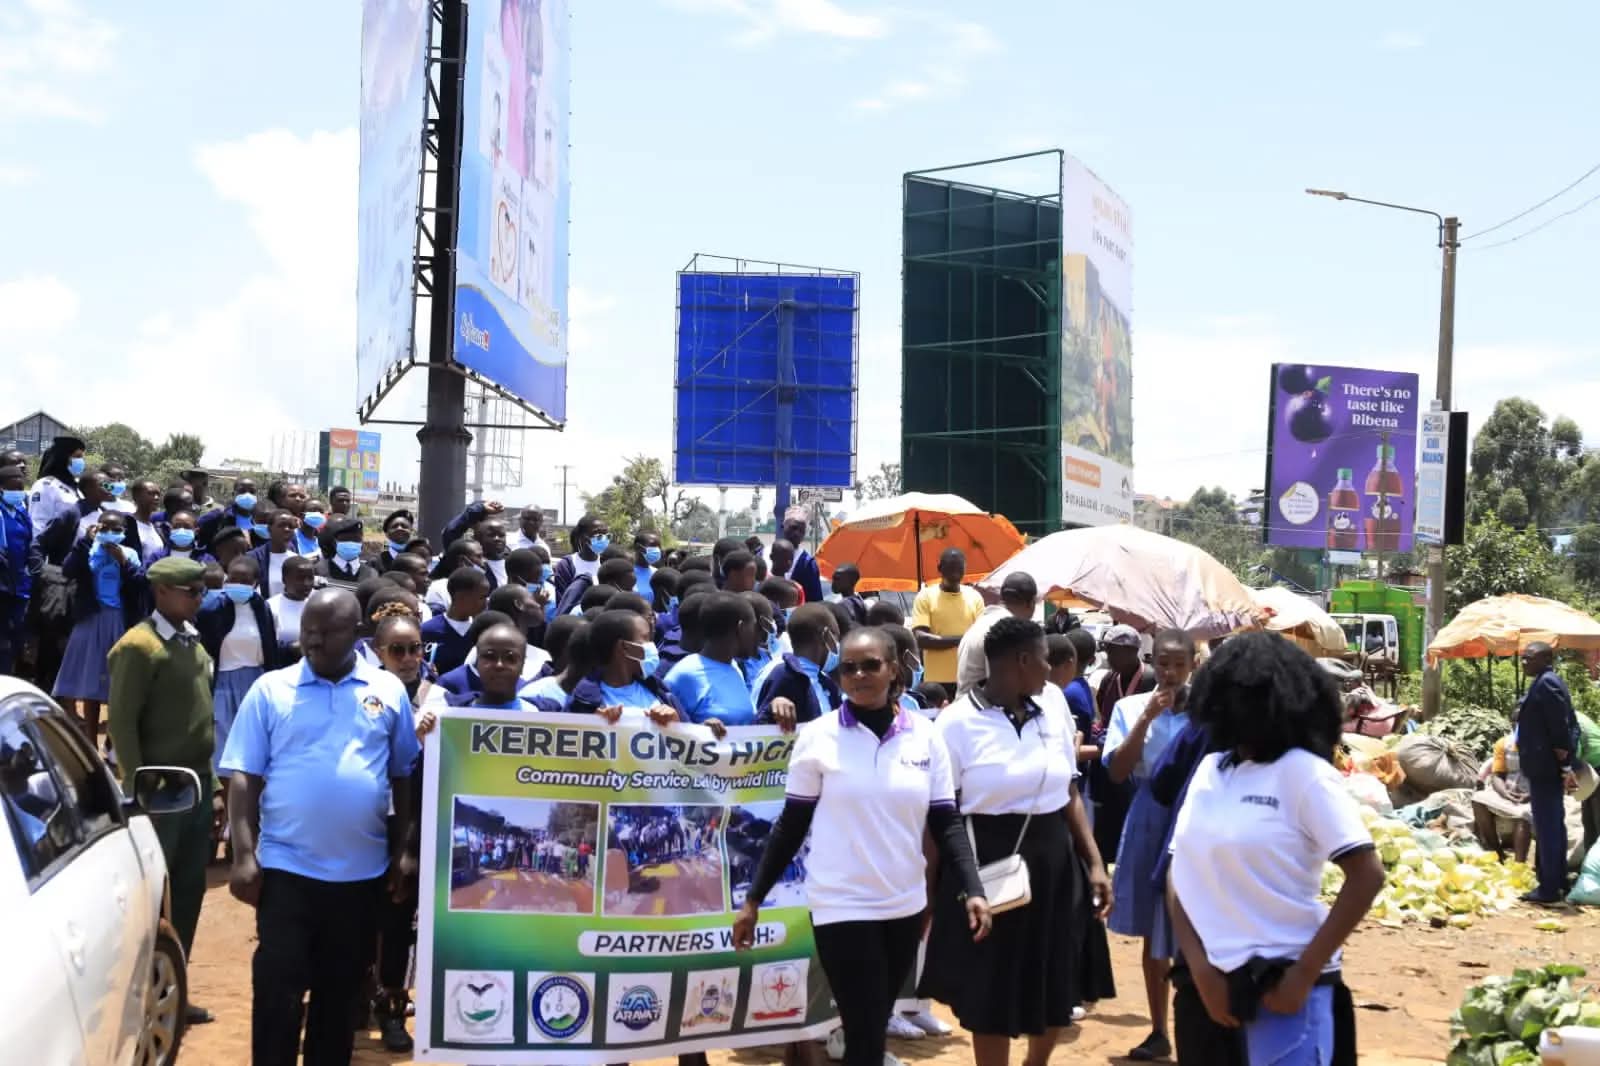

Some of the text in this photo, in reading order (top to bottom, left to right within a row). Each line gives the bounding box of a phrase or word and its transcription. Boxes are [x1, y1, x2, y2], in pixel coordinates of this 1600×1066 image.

[1343, 384, 1411, 399] There's no
[1347, 399, 1404, 413] taste like
[1352, 414, 1398, 427] Ribena
[471, 724, 617, 760] KERERI
[630, 731, 720, 766] GIRLS
[517, 767, 627, 790] Community
[631, 771, 690, 788] Service
[711, 774, 729, 793] by
[731, 772, 763, 788] wild
[594, 927, 775, 953] PARTNERS WH:
